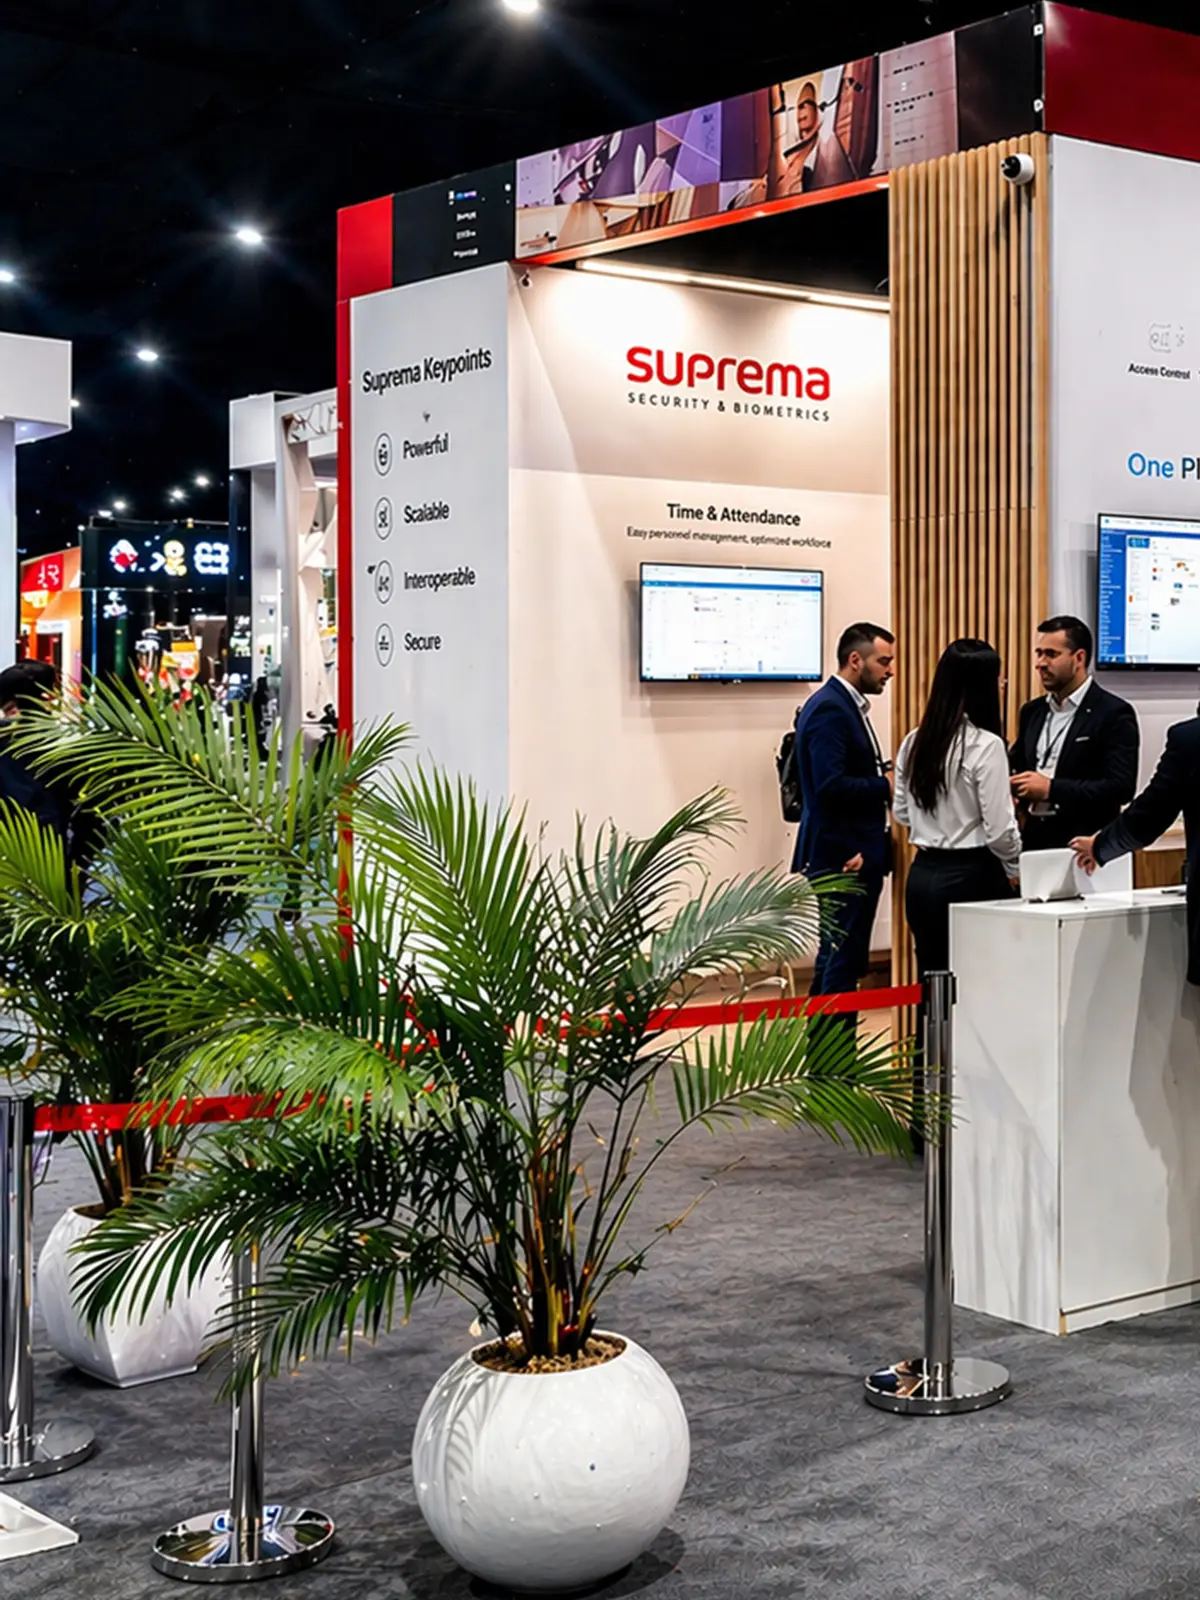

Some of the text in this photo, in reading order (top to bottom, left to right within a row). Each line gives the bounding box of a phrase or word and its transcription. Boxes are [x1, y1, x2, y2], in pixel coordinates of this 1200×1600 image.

[362, 347, 493, 396] Suprema Keypoints
[1128, 363, 1191, 380] Access Control
[627, 391, 830, 422] SECURITY & BIOMETRICS
[403, 432, 449, 460] Powerful
[1128, 452, 1174, 479] One
[404, 501, 450, 524] Scalable
[667, 503, 801, 527] Time & Attendance
[404, 566, 476, 592] Interoperable
[404, 632, 442, 651] Secure
